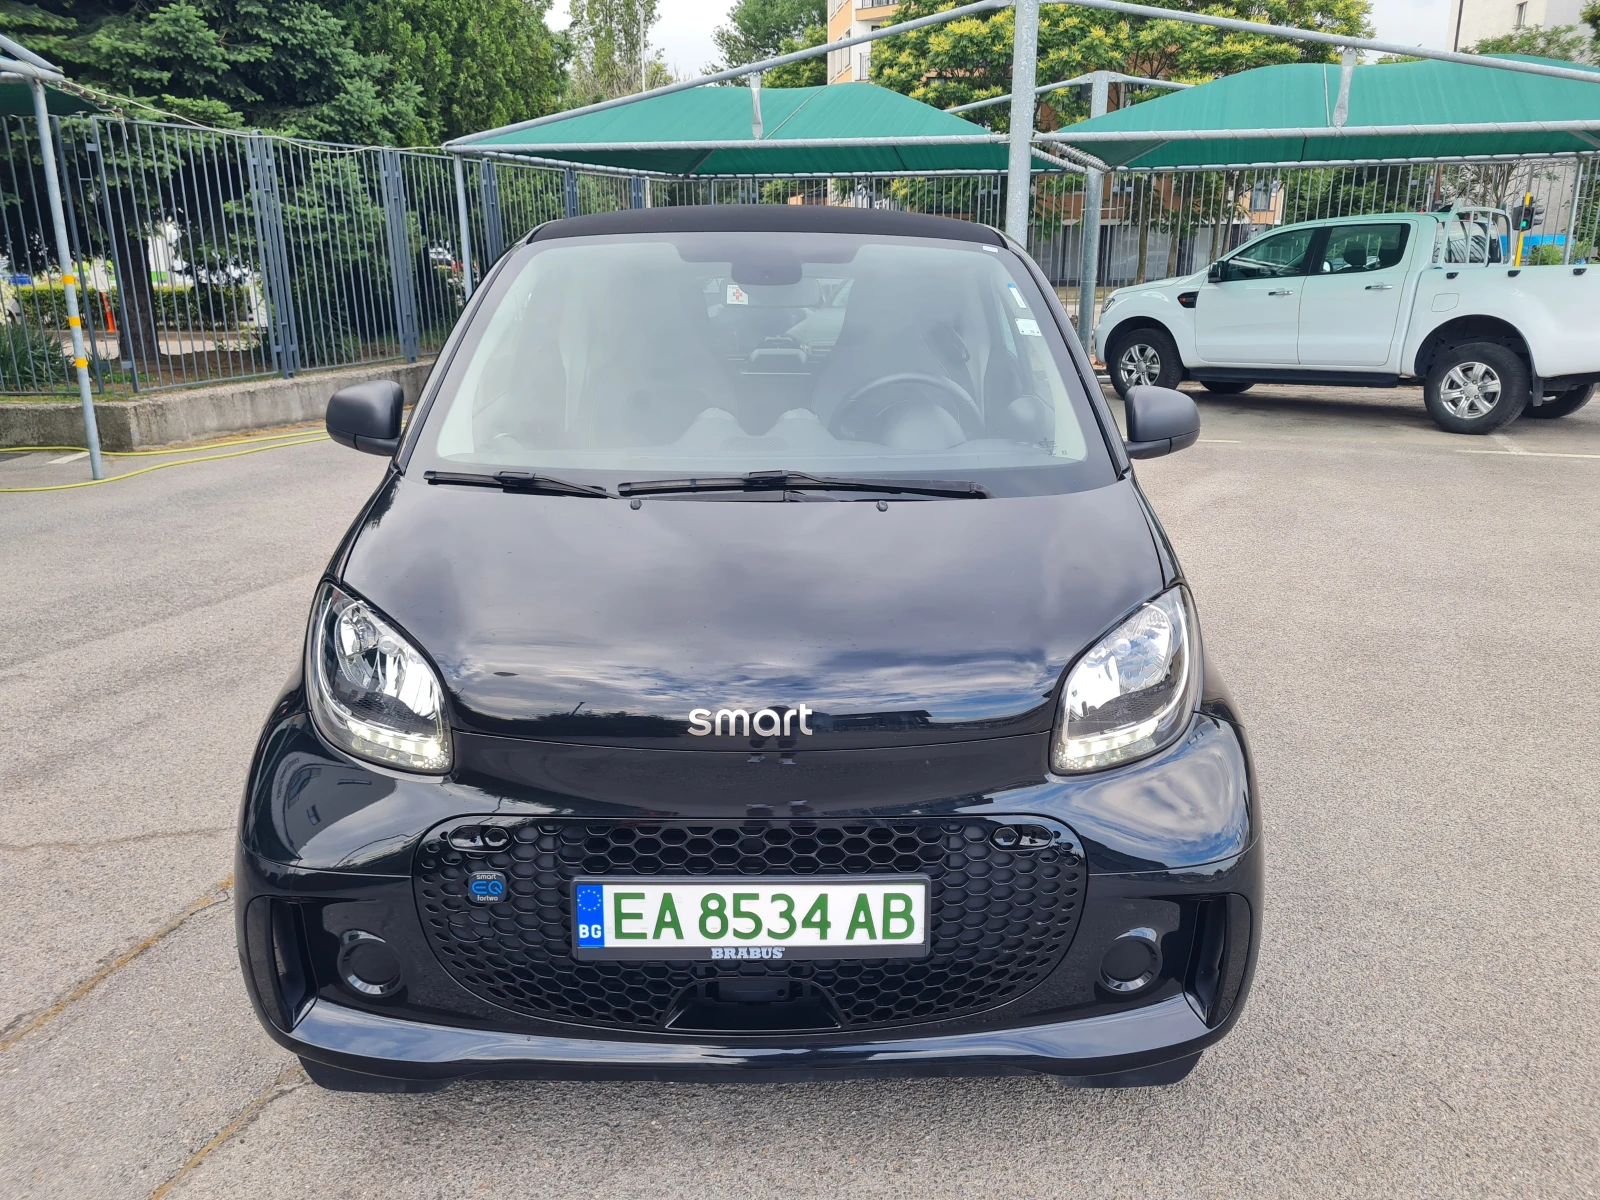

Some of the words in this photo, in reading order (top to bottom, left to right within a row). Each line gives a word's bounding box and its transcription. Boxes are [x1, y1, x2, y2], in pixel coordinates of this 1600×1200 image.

[687, 704, 813, 737] smart
[472, 881, 503, 895] EQ
[614, 893, 684, 939] EA
[699, 893, 831, 940] 8534
[846, 893, 915, 939] AB
[579, 924, 601, 938] BG
[711, 947, 785, 959] BRABUS
